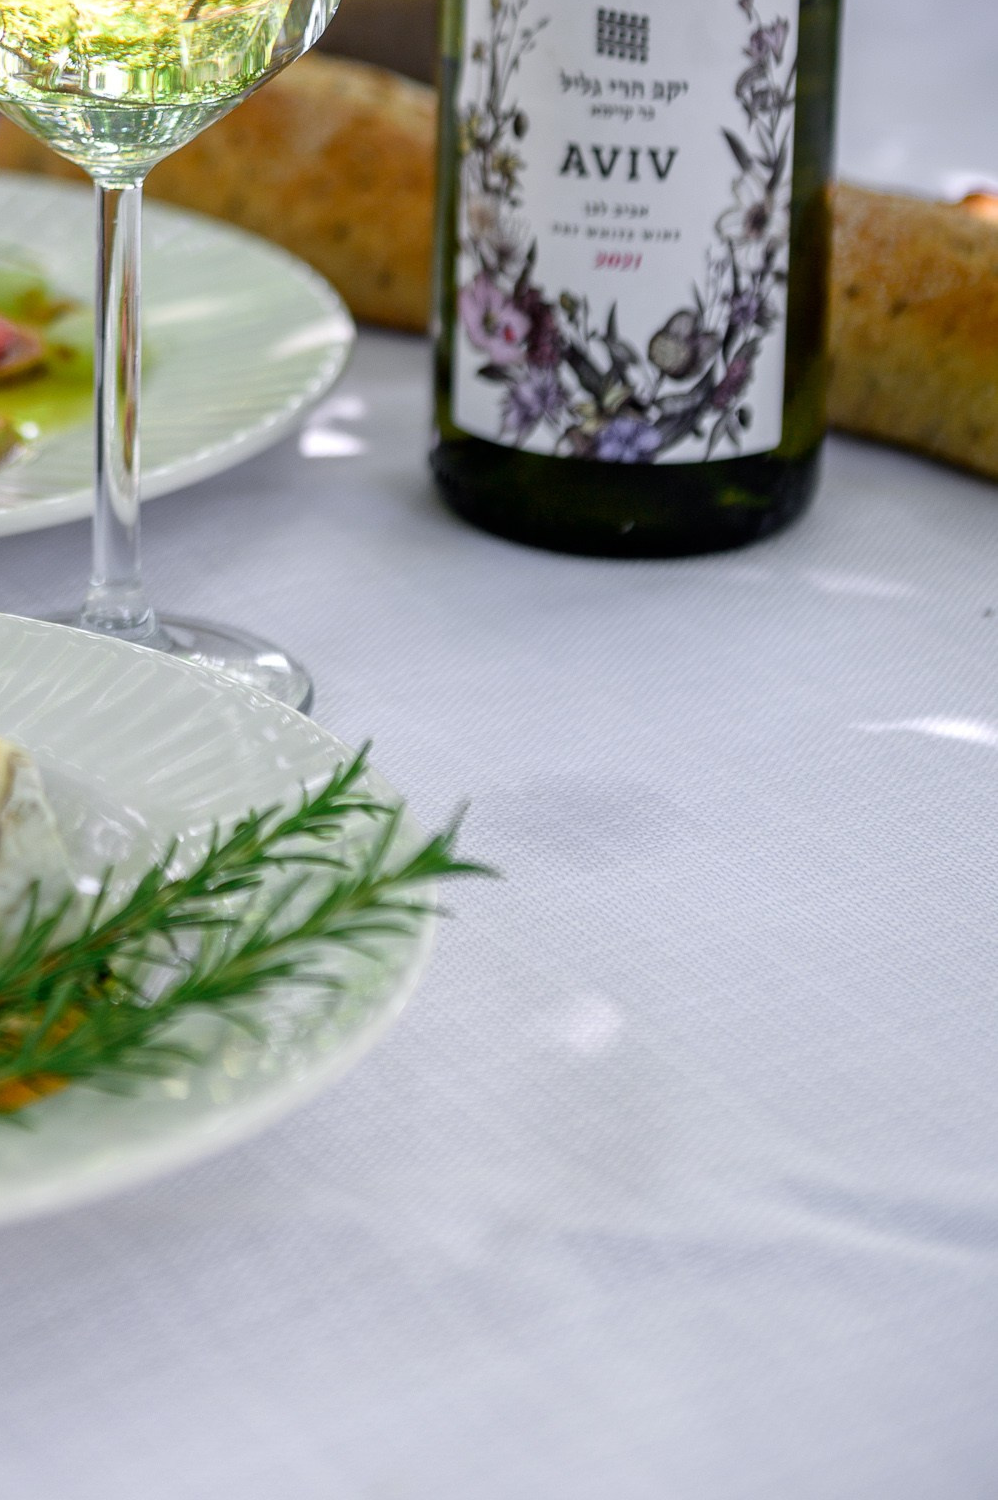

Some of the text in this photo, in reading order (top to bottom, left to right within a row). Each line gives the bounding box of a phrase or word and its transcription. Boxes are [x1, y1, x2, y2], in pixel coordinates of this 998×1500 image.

[652, 79, 689, 105] יקב
[559, 142, 680, 182] AVIV
[594, 251, 643, 270] 2021
